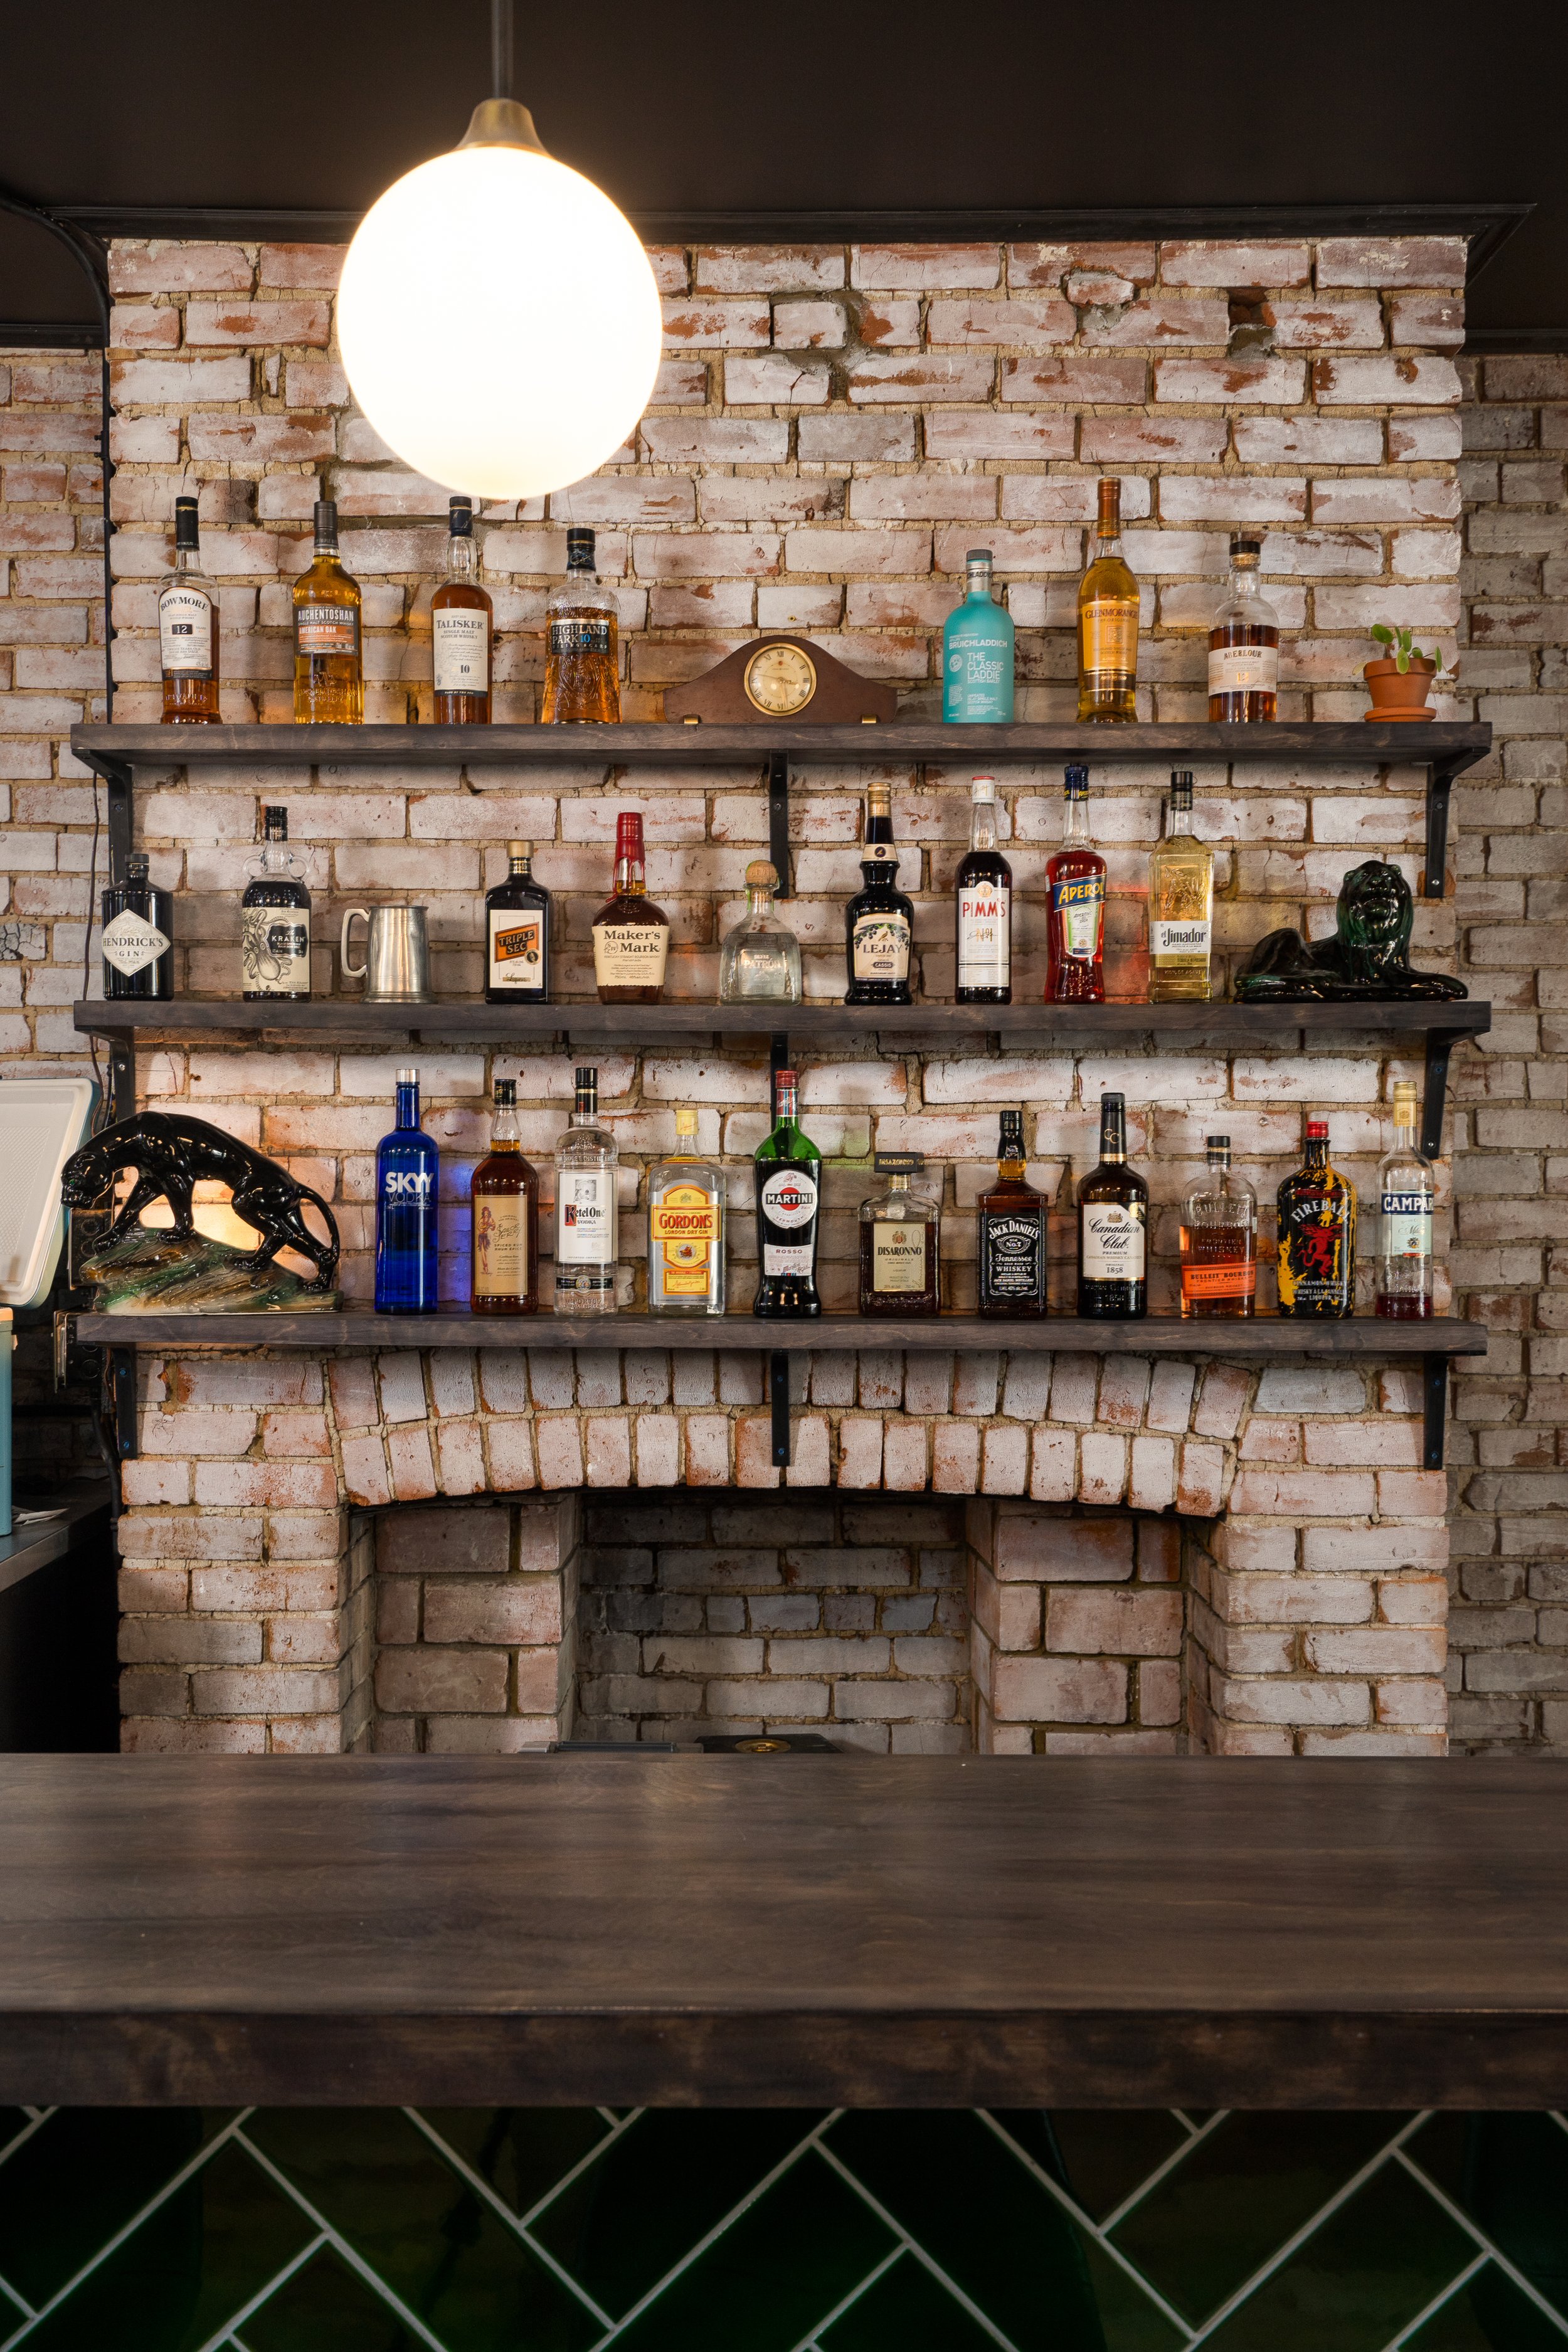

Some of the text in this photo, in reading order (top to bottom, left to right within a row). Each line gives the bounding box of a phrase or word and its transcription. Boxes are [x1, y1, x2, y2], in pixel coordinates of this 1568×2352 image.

[160, 596, 208, 612] BOWMORE
[298, 610, 354, 621] AUCHENTOSHAN
[176, 625, 188, 633] 12
[437, 620, 483, 629] TALISKER
[299, 626, 324, 634] AMERICAN
[553, 625, 607, 635] HIGHLAND
[553, 634, 590, 644] PARK 10
[949, 639, 1007, 649] BRUICHLADDICH
[967, 652, 985, 661] THE
[1224, 650, 1262, 660] ABERLOUR
[460, 665, 470, 673] 10
[967, 662, 1004, 670] CLASSIC
[968, 670, 1000, 679] LADDIE
[1058, 882, 1104, 905] APEROL
[963, 899, 1006, 918] PIMM'S
[499, 931, 533, 945] TRIPLE
[603, 930, 660, 940] Maker's
[1163, 927, 1207, 946] Jimador
[103, 937, 163, 947] HENDRICK'S
[507, 942, 526, 953] SEC
[620, 943, 660, 952] Mark
[863, 945, 902, 953] LEJAY
[385, 1172, 435, 1193] SKYY
[389, 1192, 430, 1202] VODKA
[768, 1194, 812, 1204] MARTINI
[566, 1206, 605, 1224] Ketel One
[1291, 1200, 1350, 1223] FIREBALL
[659, 1213, 712, 1229] GORDON'S
[1088, 1218, 1140, 1233] Canadian
[493, 1224, 524, 1242] JERRY
[988, 1221, 1041, 1239] JACK DANIEL'S
[1099, 1234, 1130, 1249] Club
[877, 1247, 922, 1256] DISARONNO
